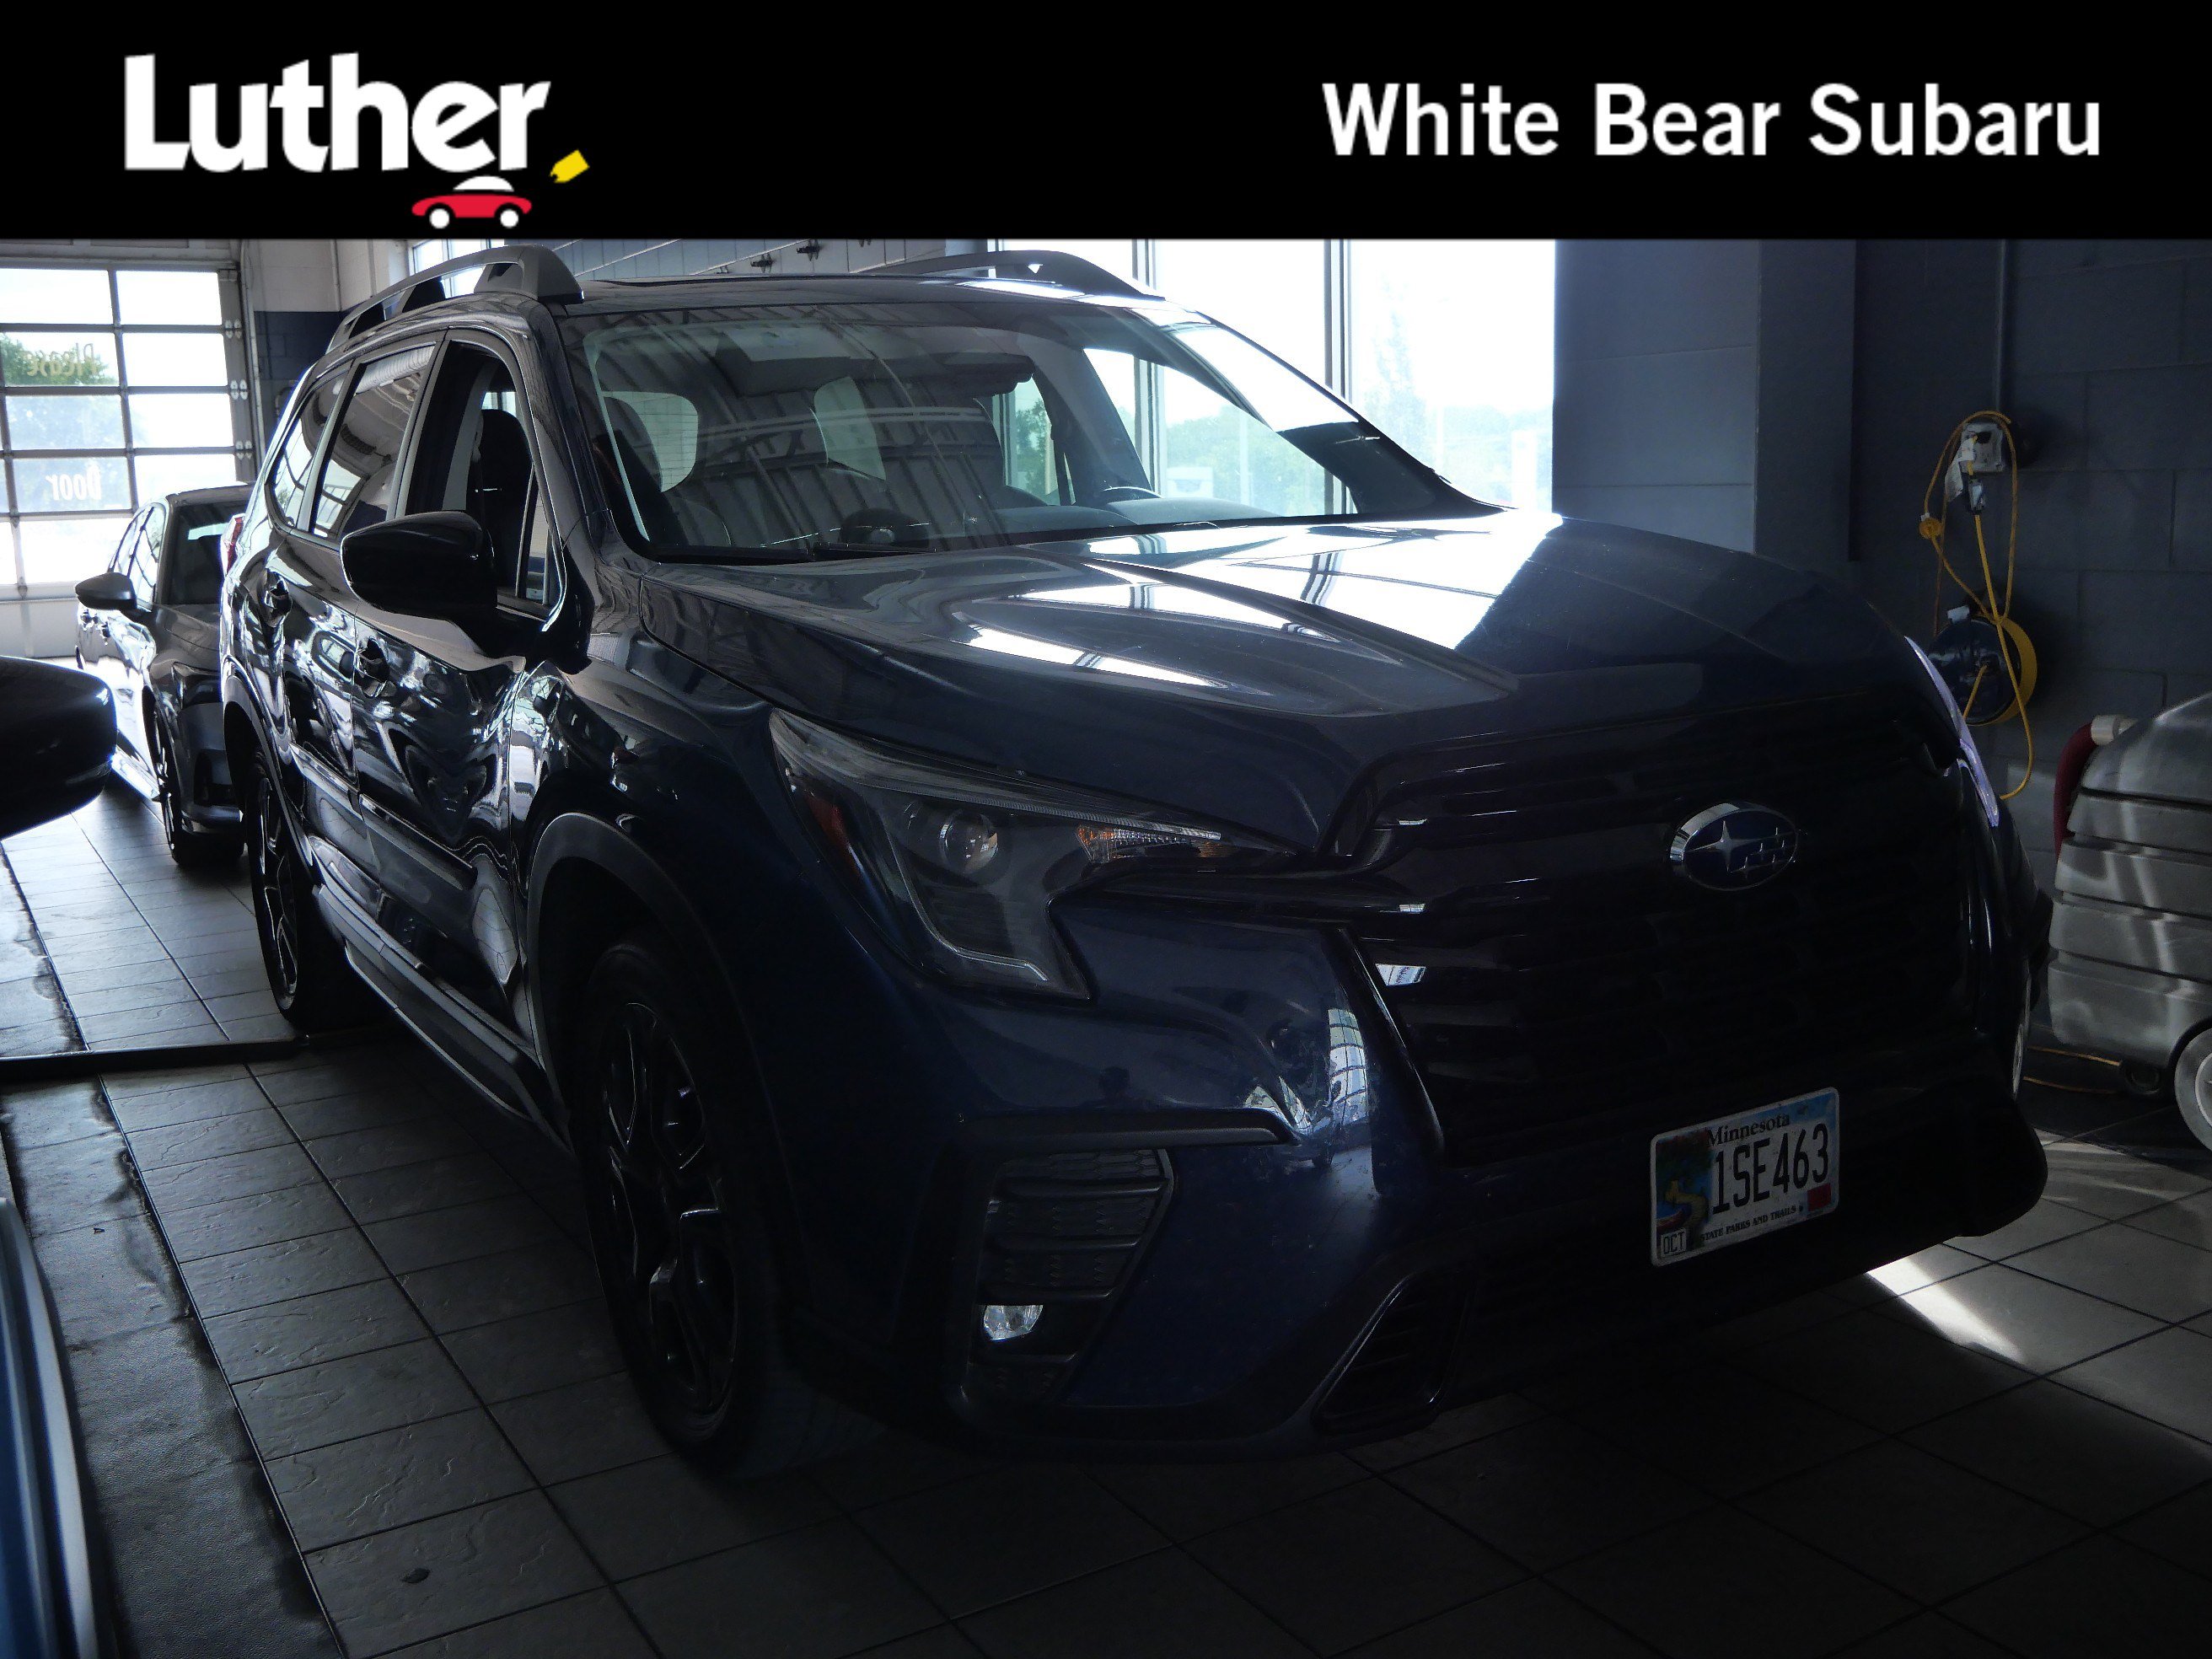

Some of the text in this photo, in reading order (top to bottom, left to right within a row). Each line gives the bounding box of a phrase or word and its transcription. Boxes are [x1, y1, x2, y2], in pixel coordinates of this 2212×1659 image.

[1707, 1114, 1791, 1146] Minnesota
[1713, 1123, 1828, 1215] 1SE463
[1700, 1228, 1724, 1241] STATE
[1726, 1220, 1751, 1235] PARKS
[1752, 1213, 1769, 1226] AND
[1662, 1231, 1685, 1255] OCT
